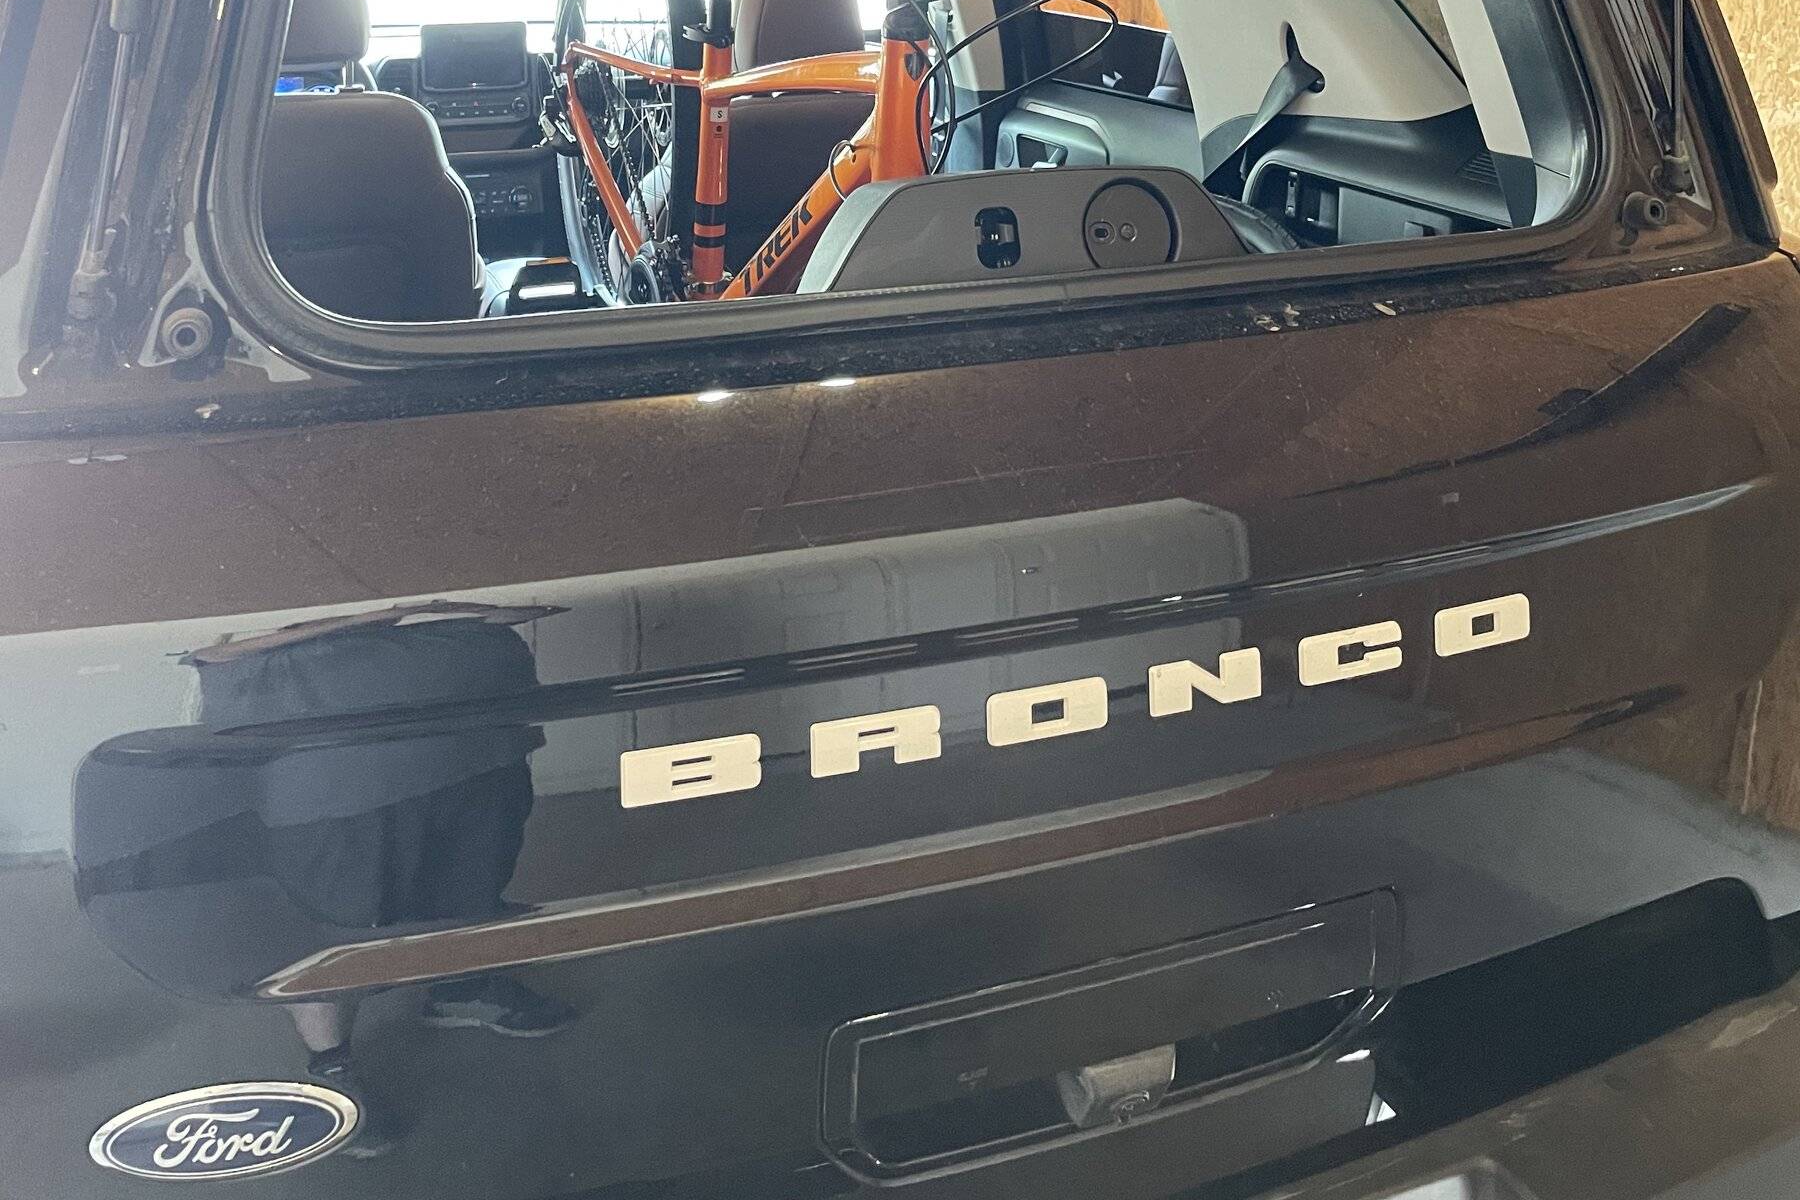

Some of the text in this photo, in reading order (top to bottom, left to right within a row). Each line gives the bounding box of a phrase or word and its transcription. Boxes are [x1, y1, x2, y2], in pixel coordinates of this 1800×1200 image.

[739, 195, 813, 295] TREK
[620, 593, 1531, 809] BRONCO
[153, 1108, 295, 1168] Ford
